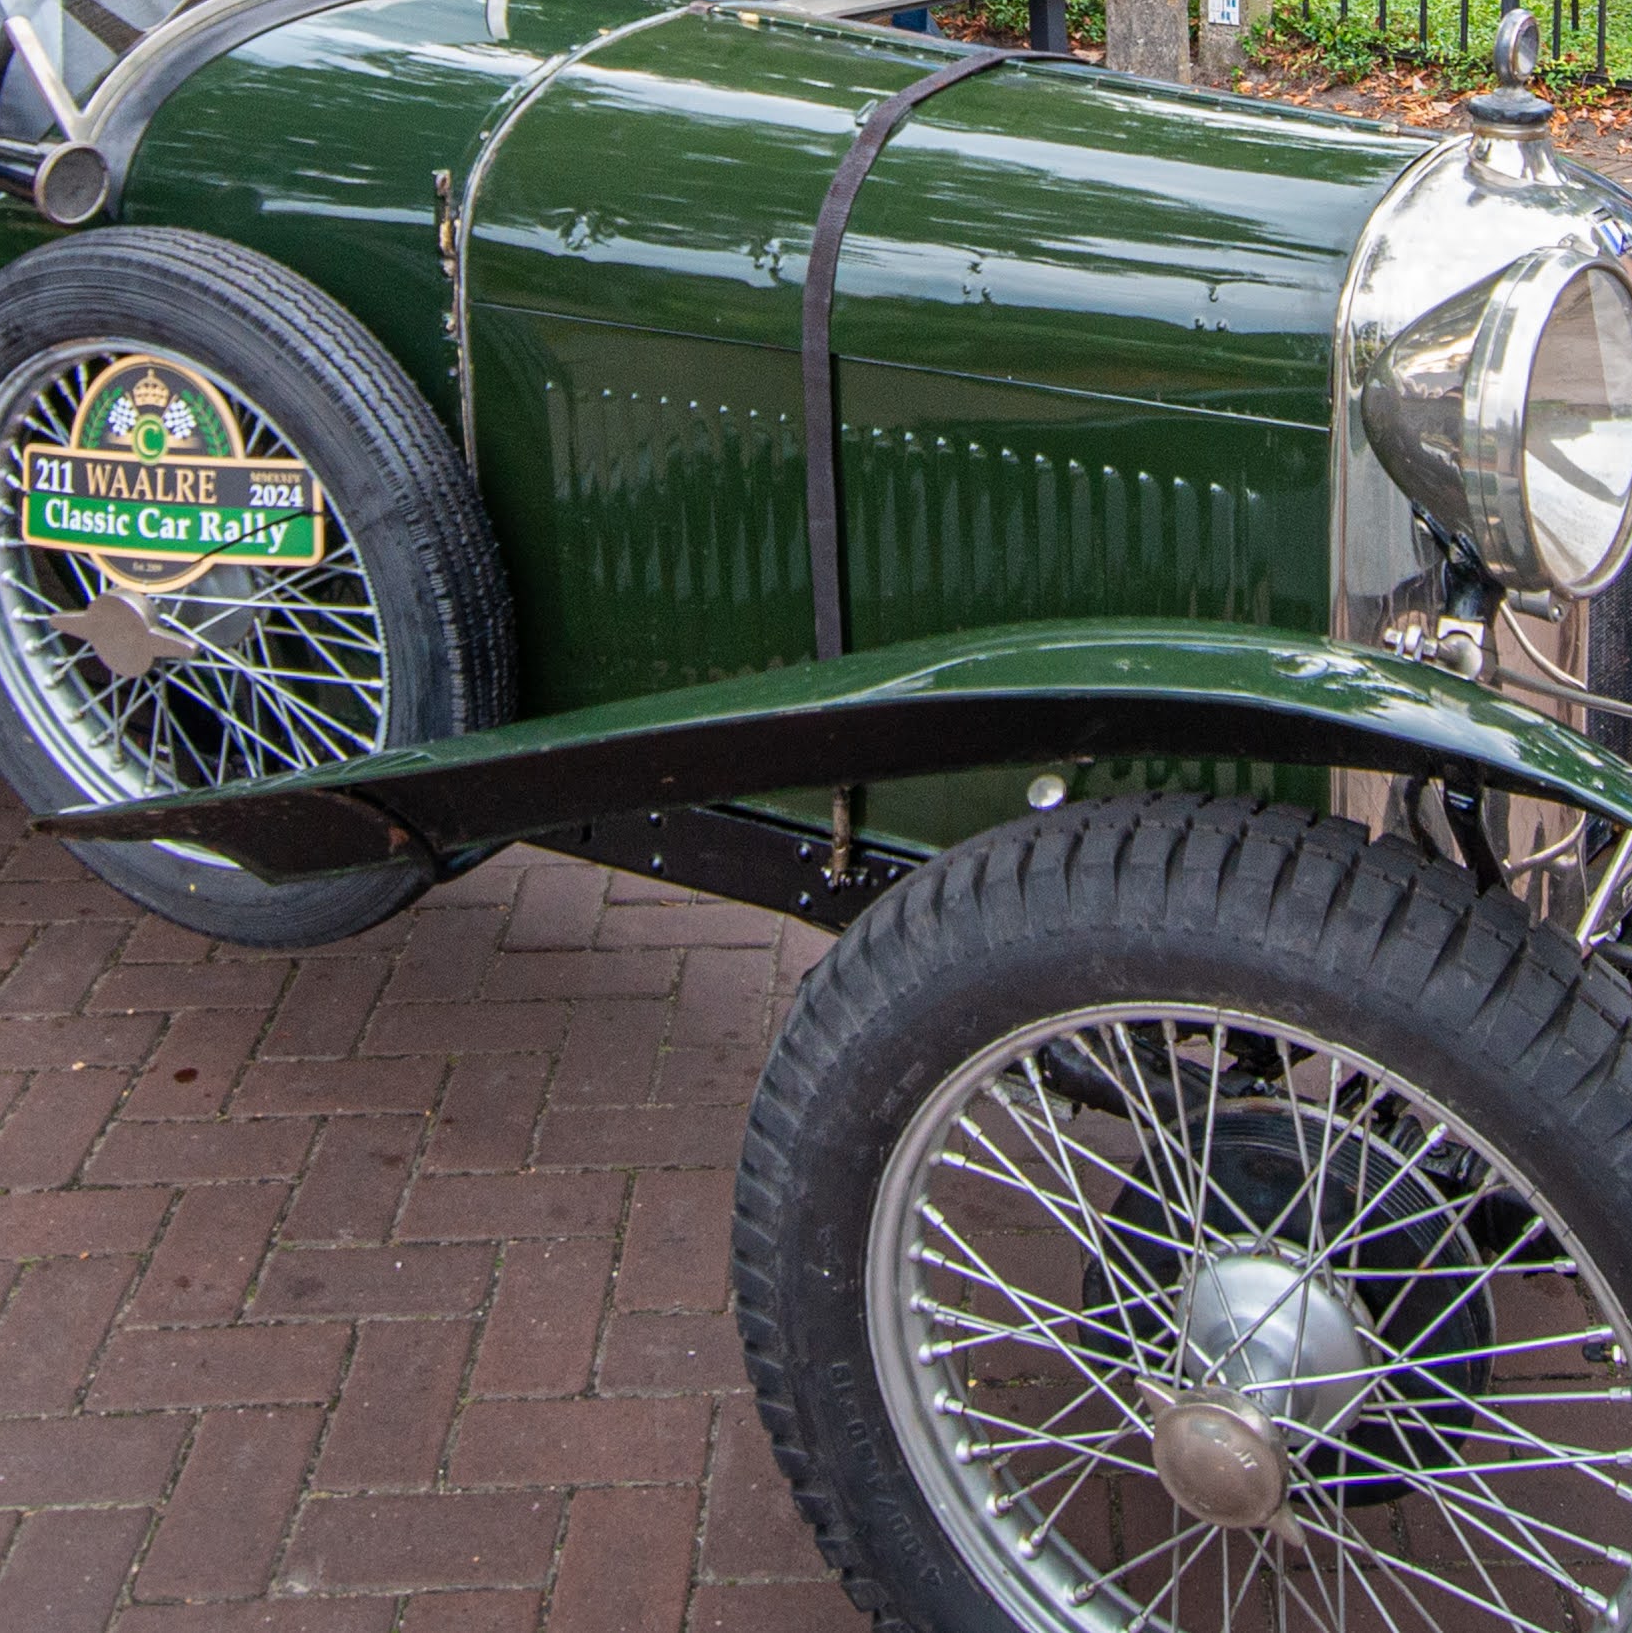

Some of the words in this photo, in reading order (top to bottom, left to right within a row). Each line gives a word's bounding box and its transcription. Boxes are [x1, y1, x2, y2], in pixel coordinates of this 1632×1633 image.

[35, 458, 75, 494] 211
[85, 462, 218, 504] WAALRE
[249, 484, 305, 508] 2024
[44, 498, 130, 536] Classic
[137, 507, 191, 541] Car
[199, 511, 289, 554] Rally
